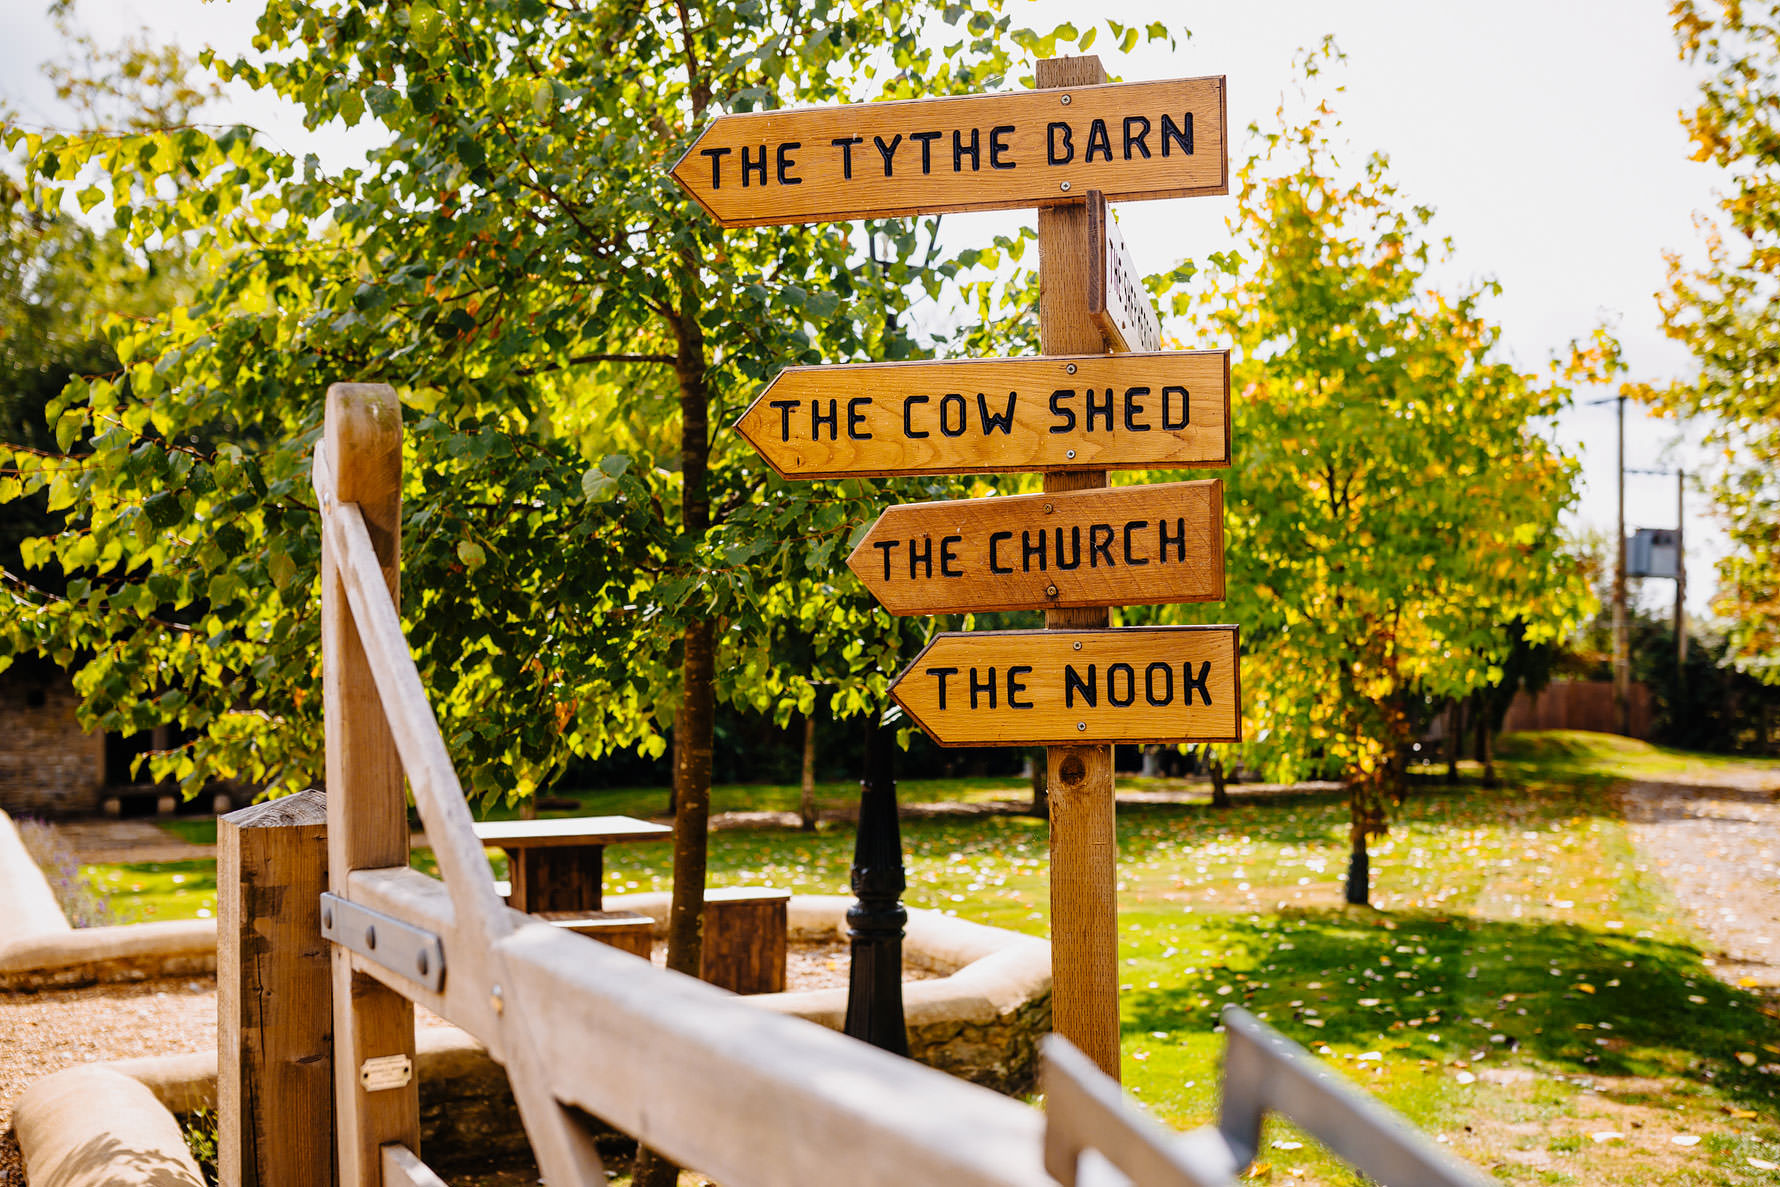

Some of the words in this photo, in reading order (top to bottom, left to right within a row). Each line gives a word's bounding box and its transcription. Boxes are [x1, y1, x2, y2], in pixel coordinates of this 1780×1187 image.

[700, 141, 803, 190] THE
[831, 125, 1017, 181] TYTHE
[1046, 111, 1194, 166] BARN
[1108, 238, 1122, 303] THE
[769, 398, 873, 443] THE
[902, 391, 1018, 439] COW
[1048, 385, 1190, 434] SHED
[873, 535, 964, 582] THE
[988, 517, 1187, 575] CHURCH
[926, 665, 1034, 711] THE
[1064, 660, 1213, 709] NOOK
